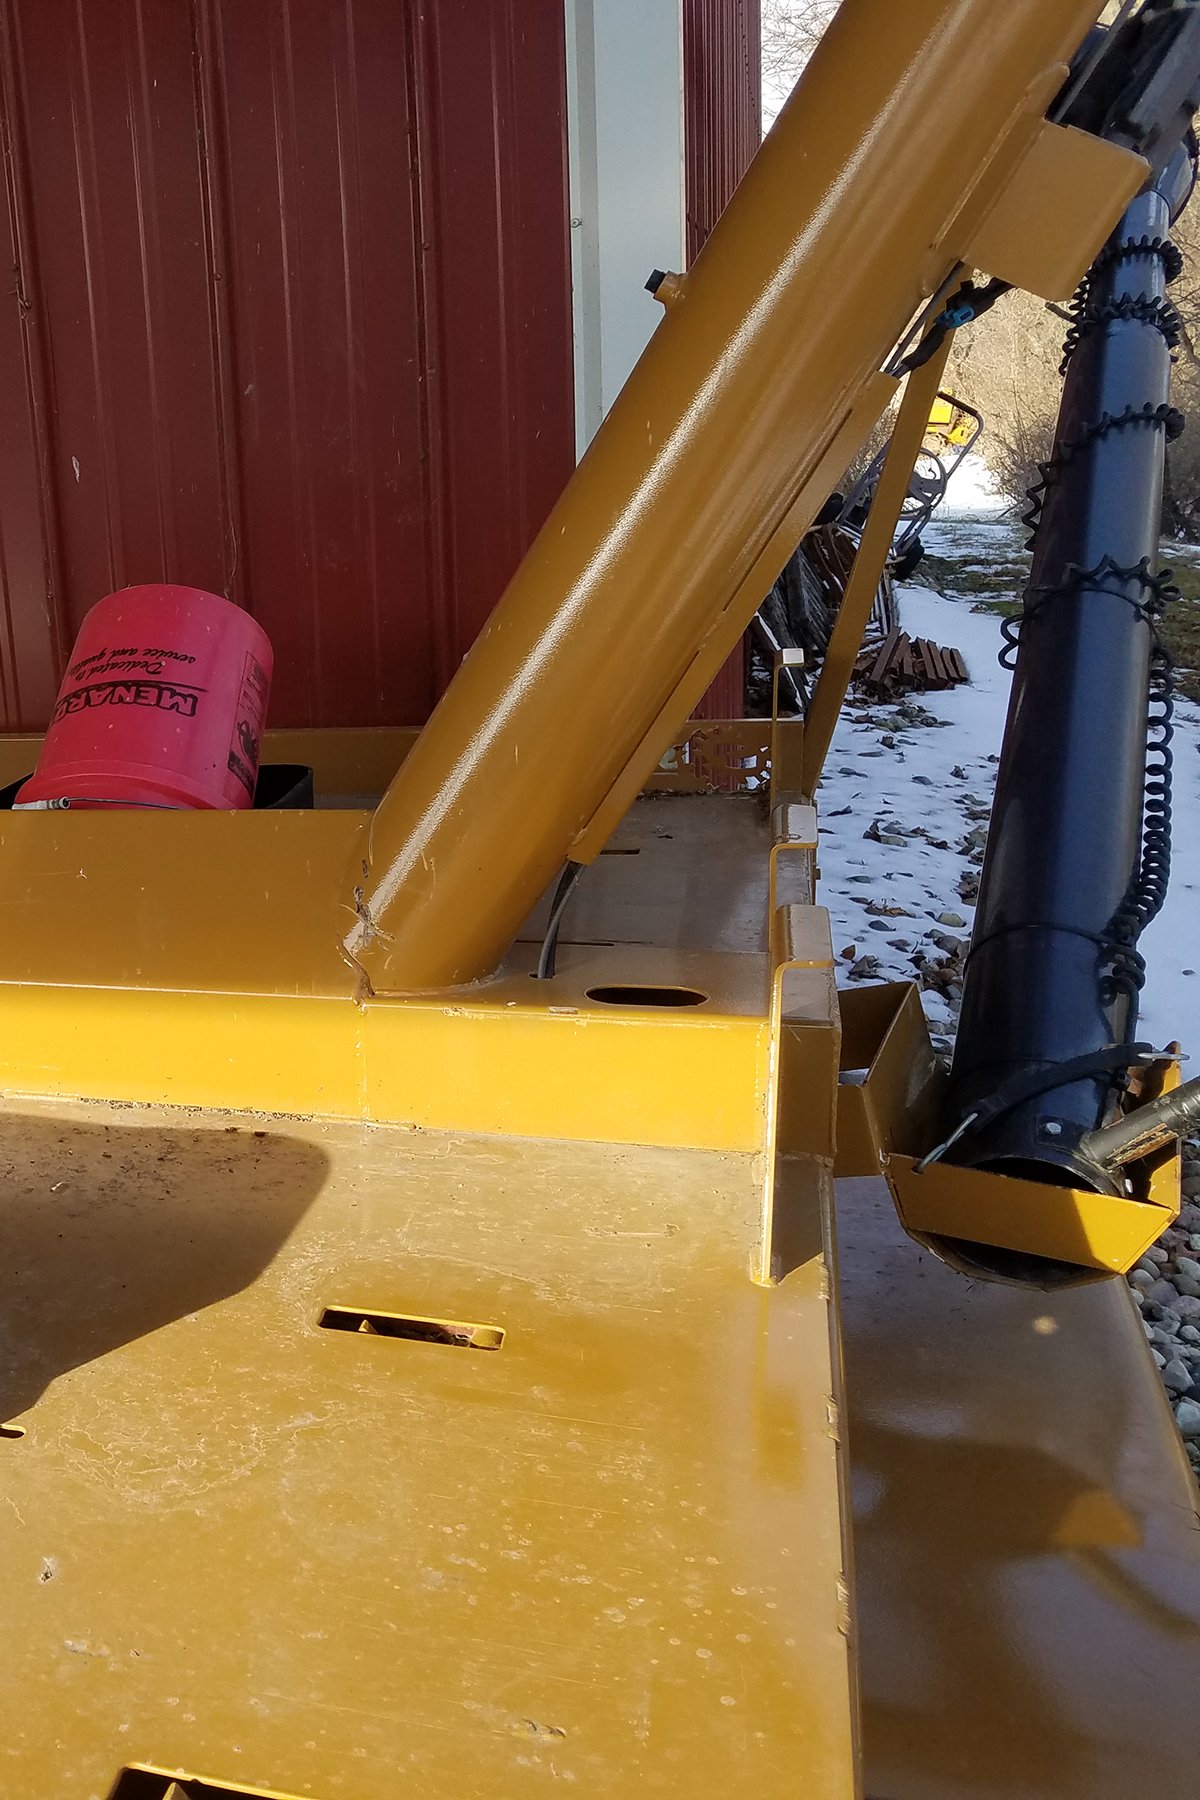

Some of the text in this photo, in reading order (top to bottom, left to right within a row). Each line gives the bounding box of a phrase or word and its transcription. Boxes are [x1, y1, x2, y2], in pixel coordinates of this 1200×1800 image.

[107, 648, 139, 661] and
[143, 648, 196, 664] service
[86, 660, 163, 680] Dedicated
